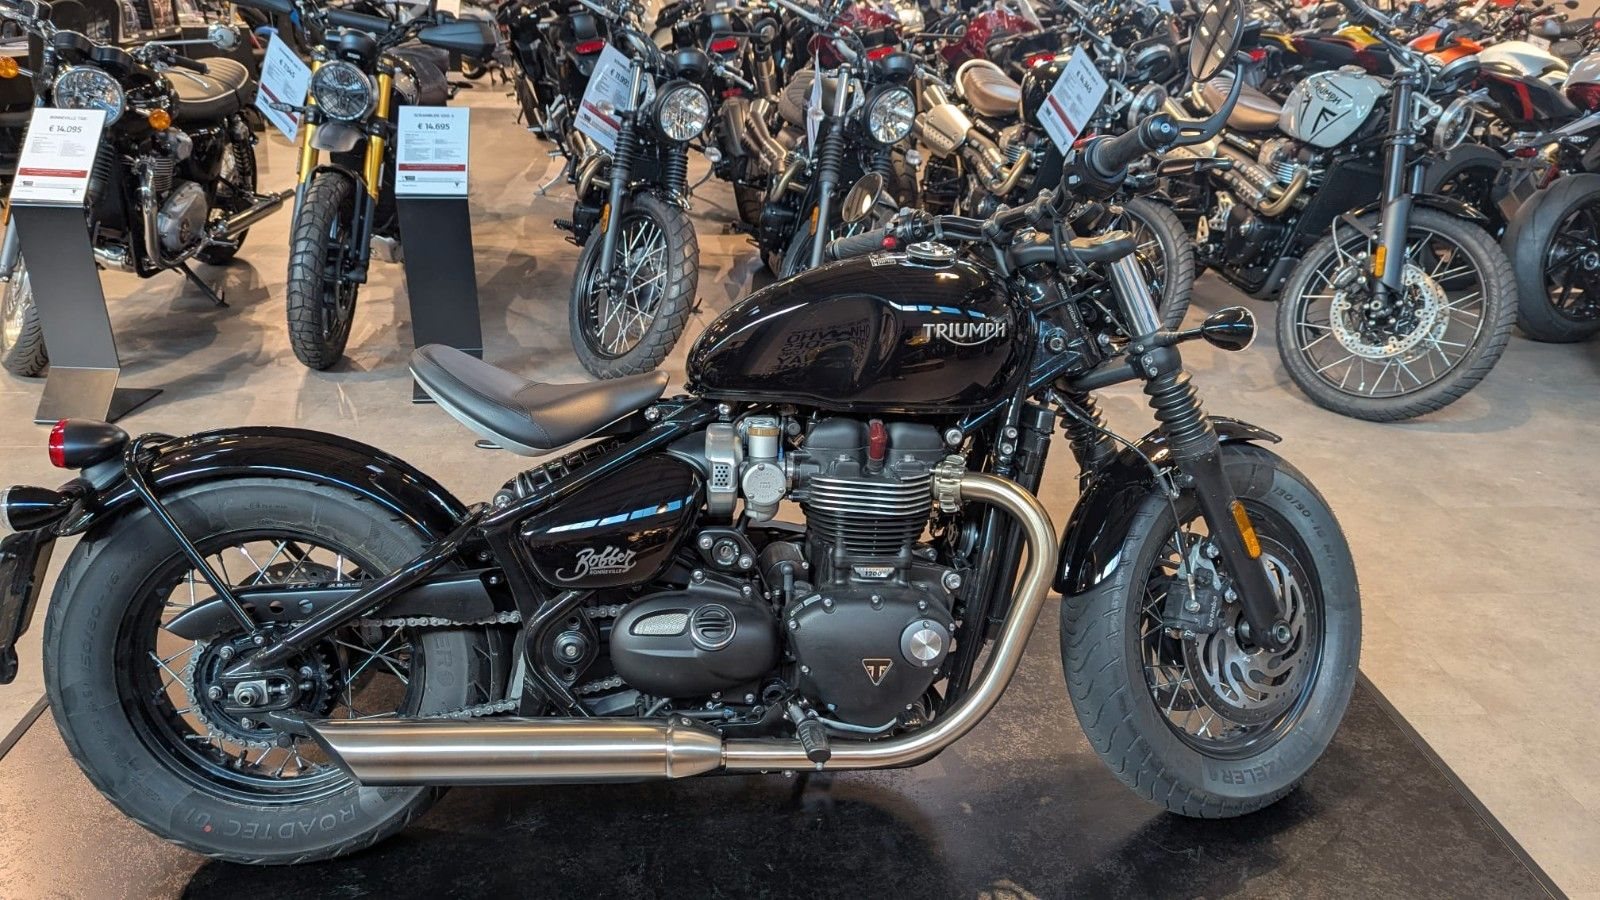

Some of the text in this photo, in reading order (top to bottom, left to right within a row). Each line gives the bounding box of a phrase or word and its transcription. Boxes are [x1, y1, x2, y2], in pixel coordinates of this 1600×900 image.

[1314, 81, 1342, 106] TRIUMPH
[56, 125, 82, 133] 14.095
[922, 322, 1007, 346] TRIUMPH
[558, 545, 637, 581] Bobber
[1206, 596, 1218, 628] brembo
[223, 803, 357, 841] ROADTEC
